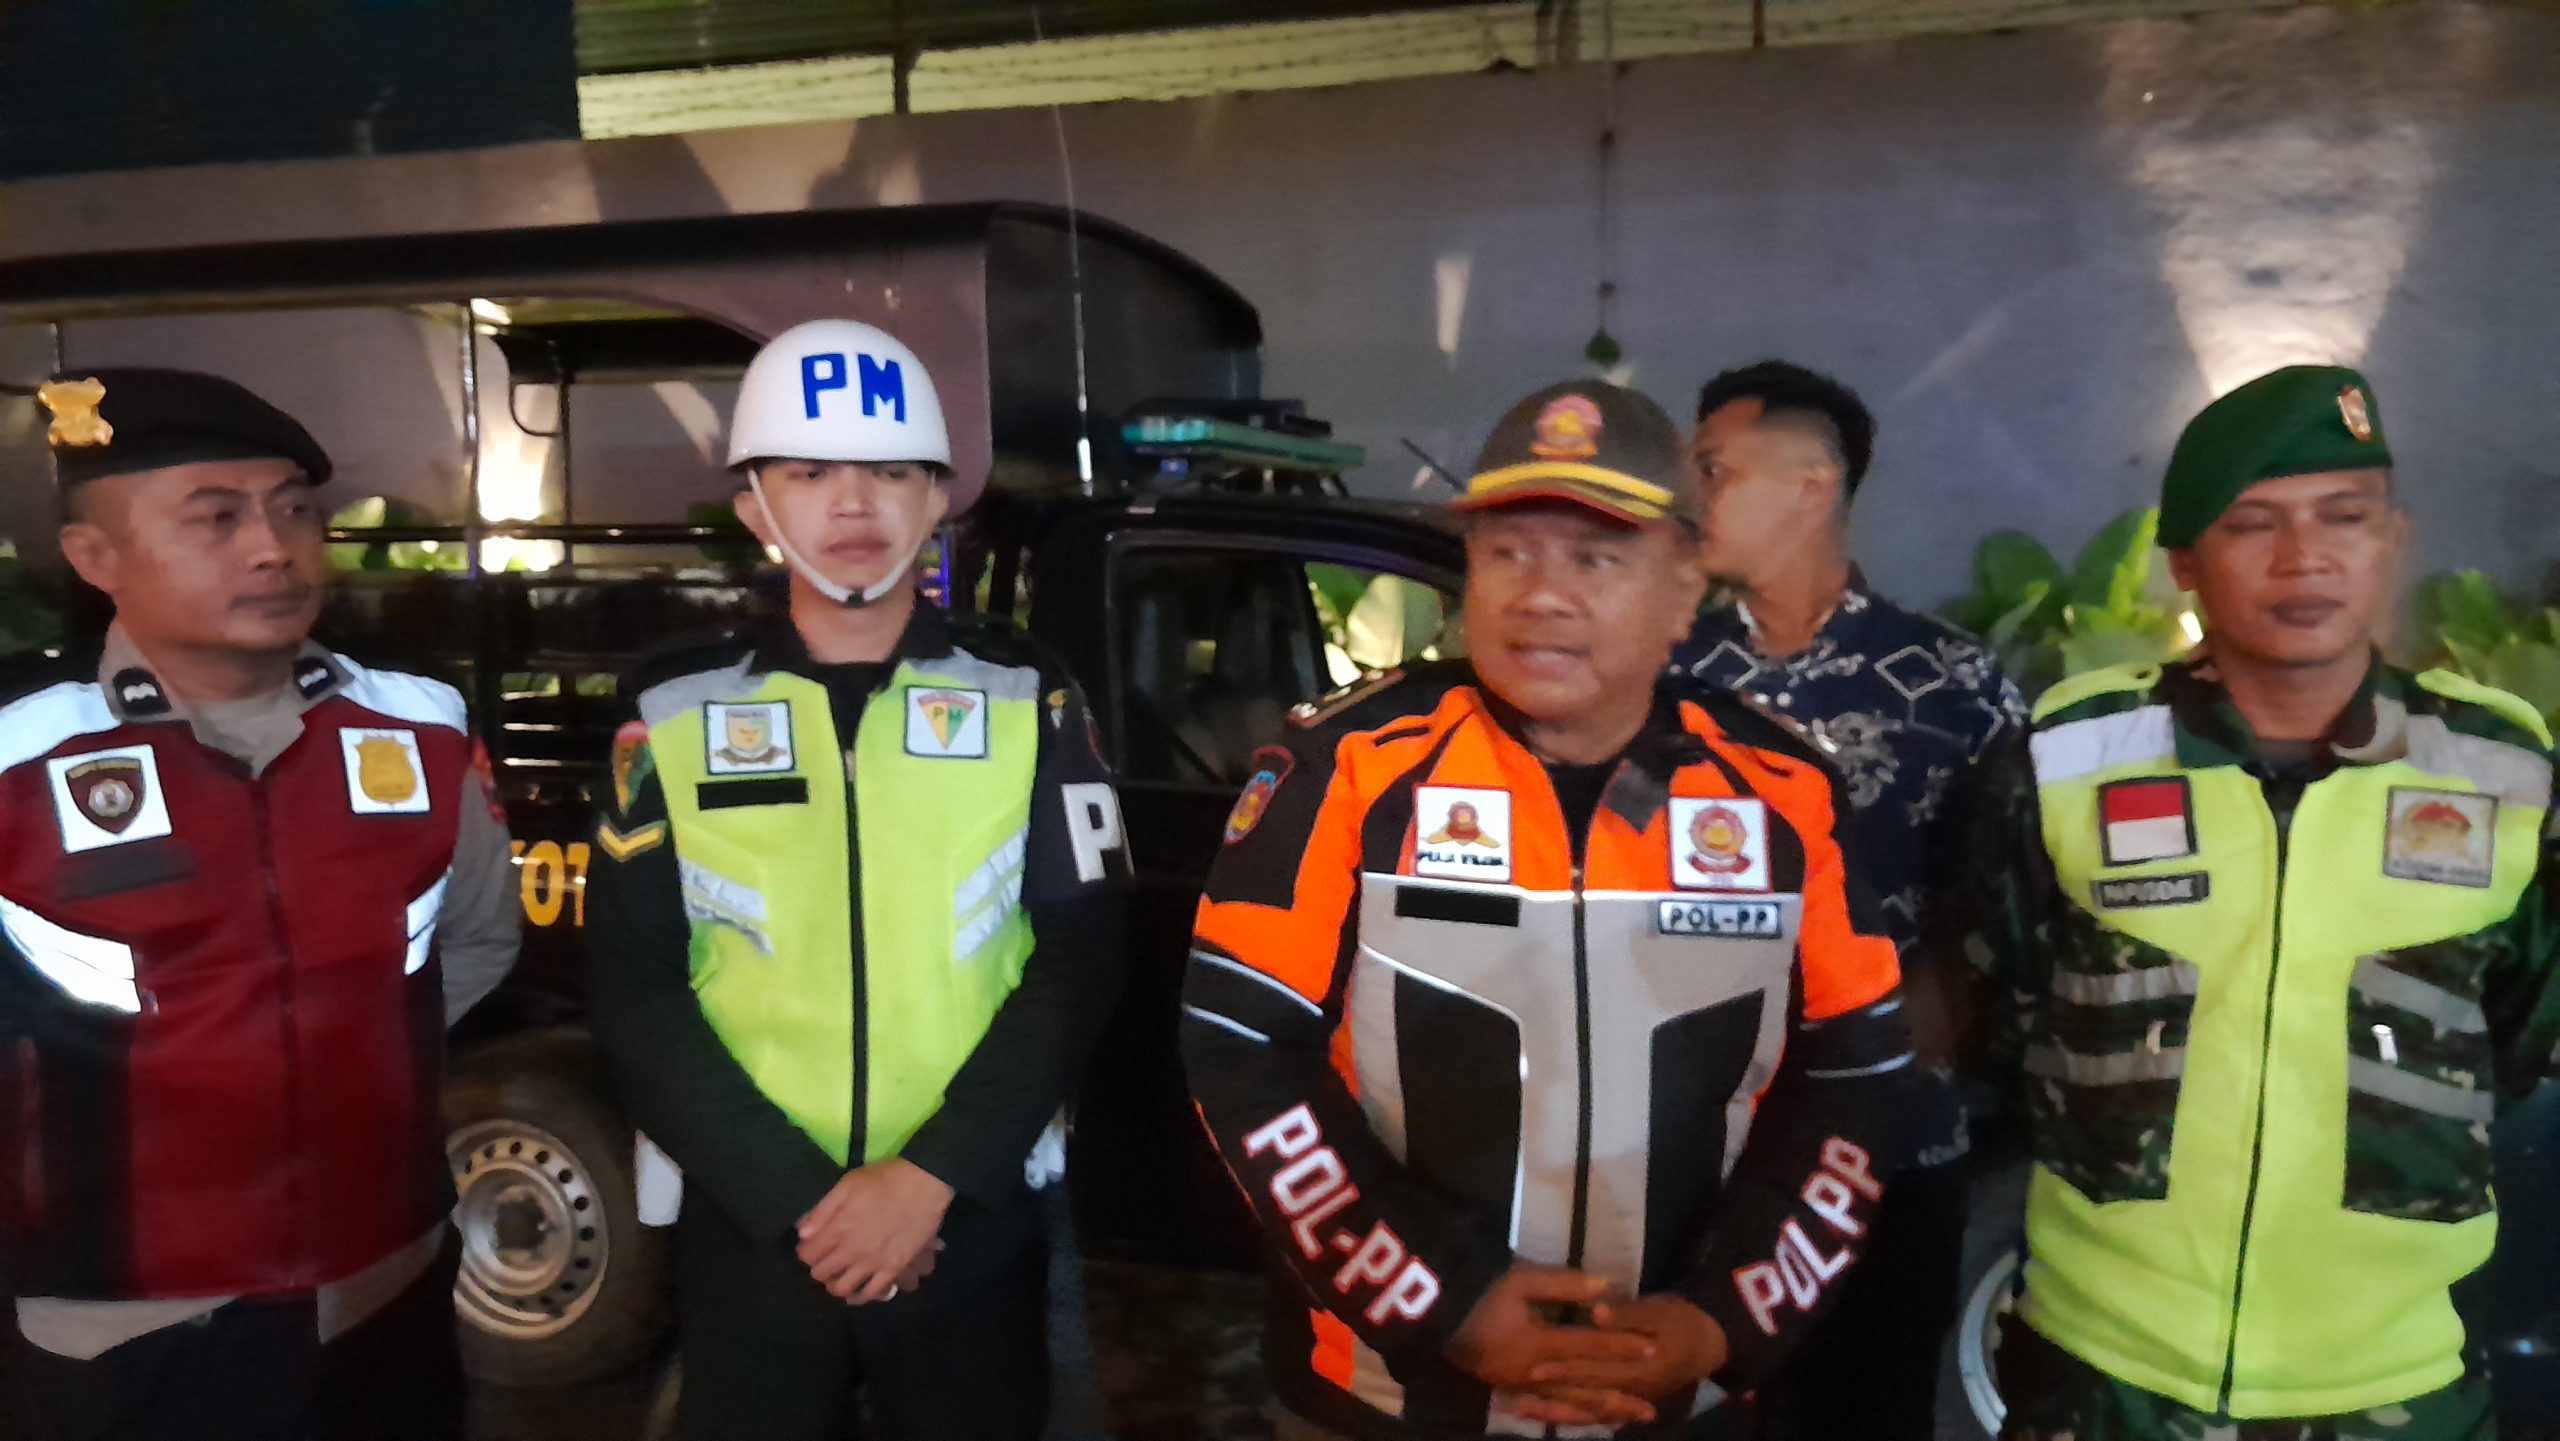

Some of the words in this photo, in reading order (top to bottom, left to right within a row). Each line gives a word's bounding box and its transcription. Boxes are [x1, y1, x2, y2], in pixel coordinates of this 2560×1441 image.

[800, 353, 906, 423] PM
[1670, 906, 1769, 933] POL-PP
[1241, 1100, 1441, 1326] POL-PP
